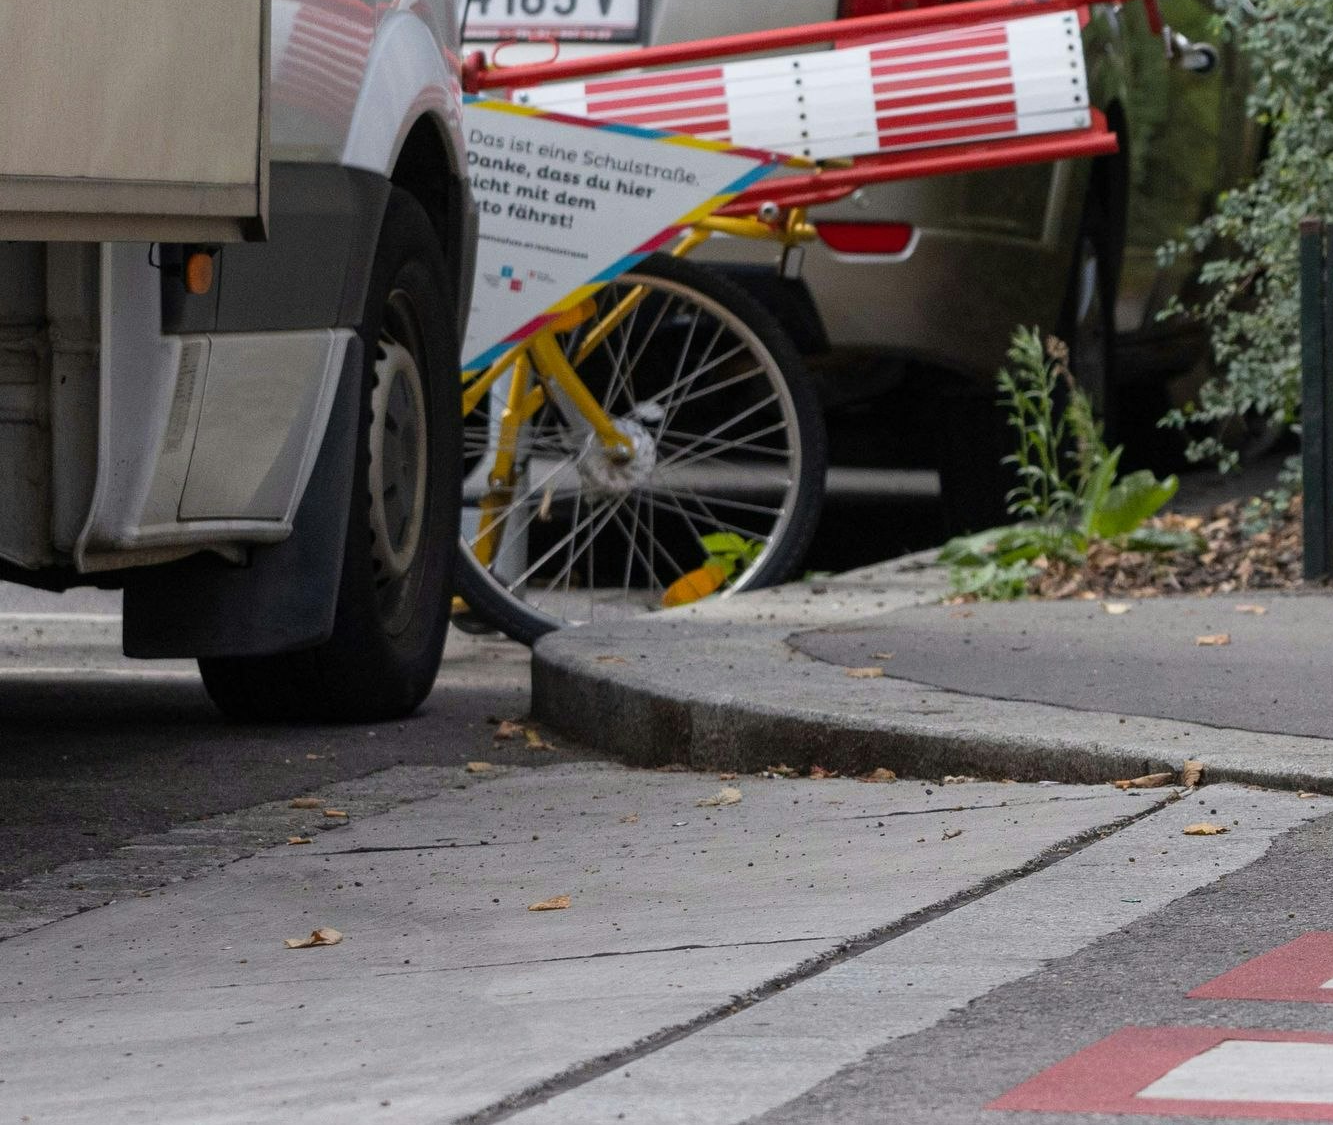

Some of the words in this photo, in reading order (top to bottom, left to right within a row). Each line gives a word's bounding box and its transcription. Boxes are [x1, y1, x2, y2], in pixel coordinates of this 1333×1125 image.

[467, 150, 530, 179] Danke,
[537, 165, 581, 186] dass
[586, 174, 610, 192] du
[616, 178, 655, 199] hier
[470, 128, 505, 149] Das
[510, 136, 533, 154] ist
[538, 143, 578, 162] eine
[583, 149, 700, 187] Schulstraße.
[475, 199, 502, 216] to
[508, 202, 575, 229] fährst!
[516, 184, 549, 202] mit
[554, 191, 596, 211] dem
